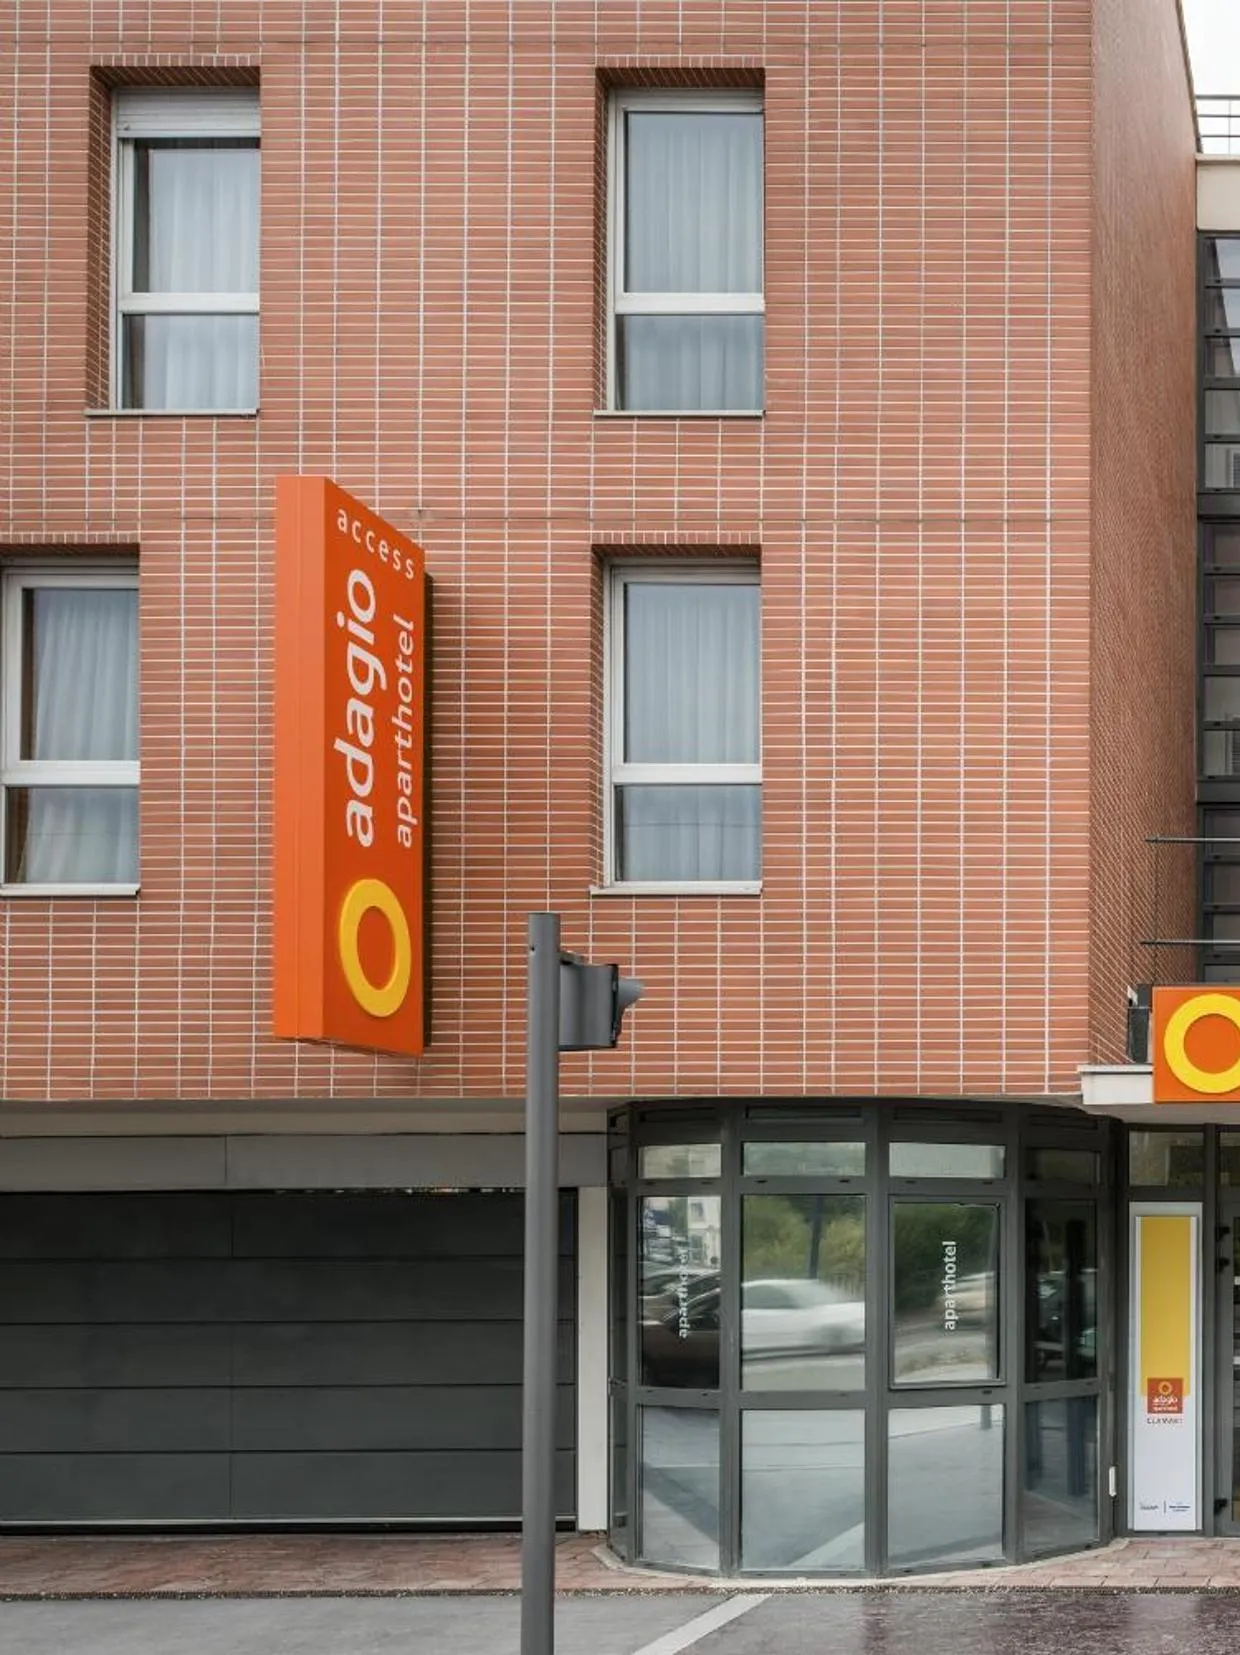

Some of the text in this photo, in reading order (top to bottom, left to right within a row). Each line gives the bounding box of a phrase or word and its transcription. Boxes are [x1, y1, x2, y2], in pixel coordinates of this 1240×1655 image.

[337, 508, 414, 579] access
[334, 569, 387, 847] adagio
[391, 614, 418, 849] aparthotel
[941, 1240, 959, 1331] aparthotel
